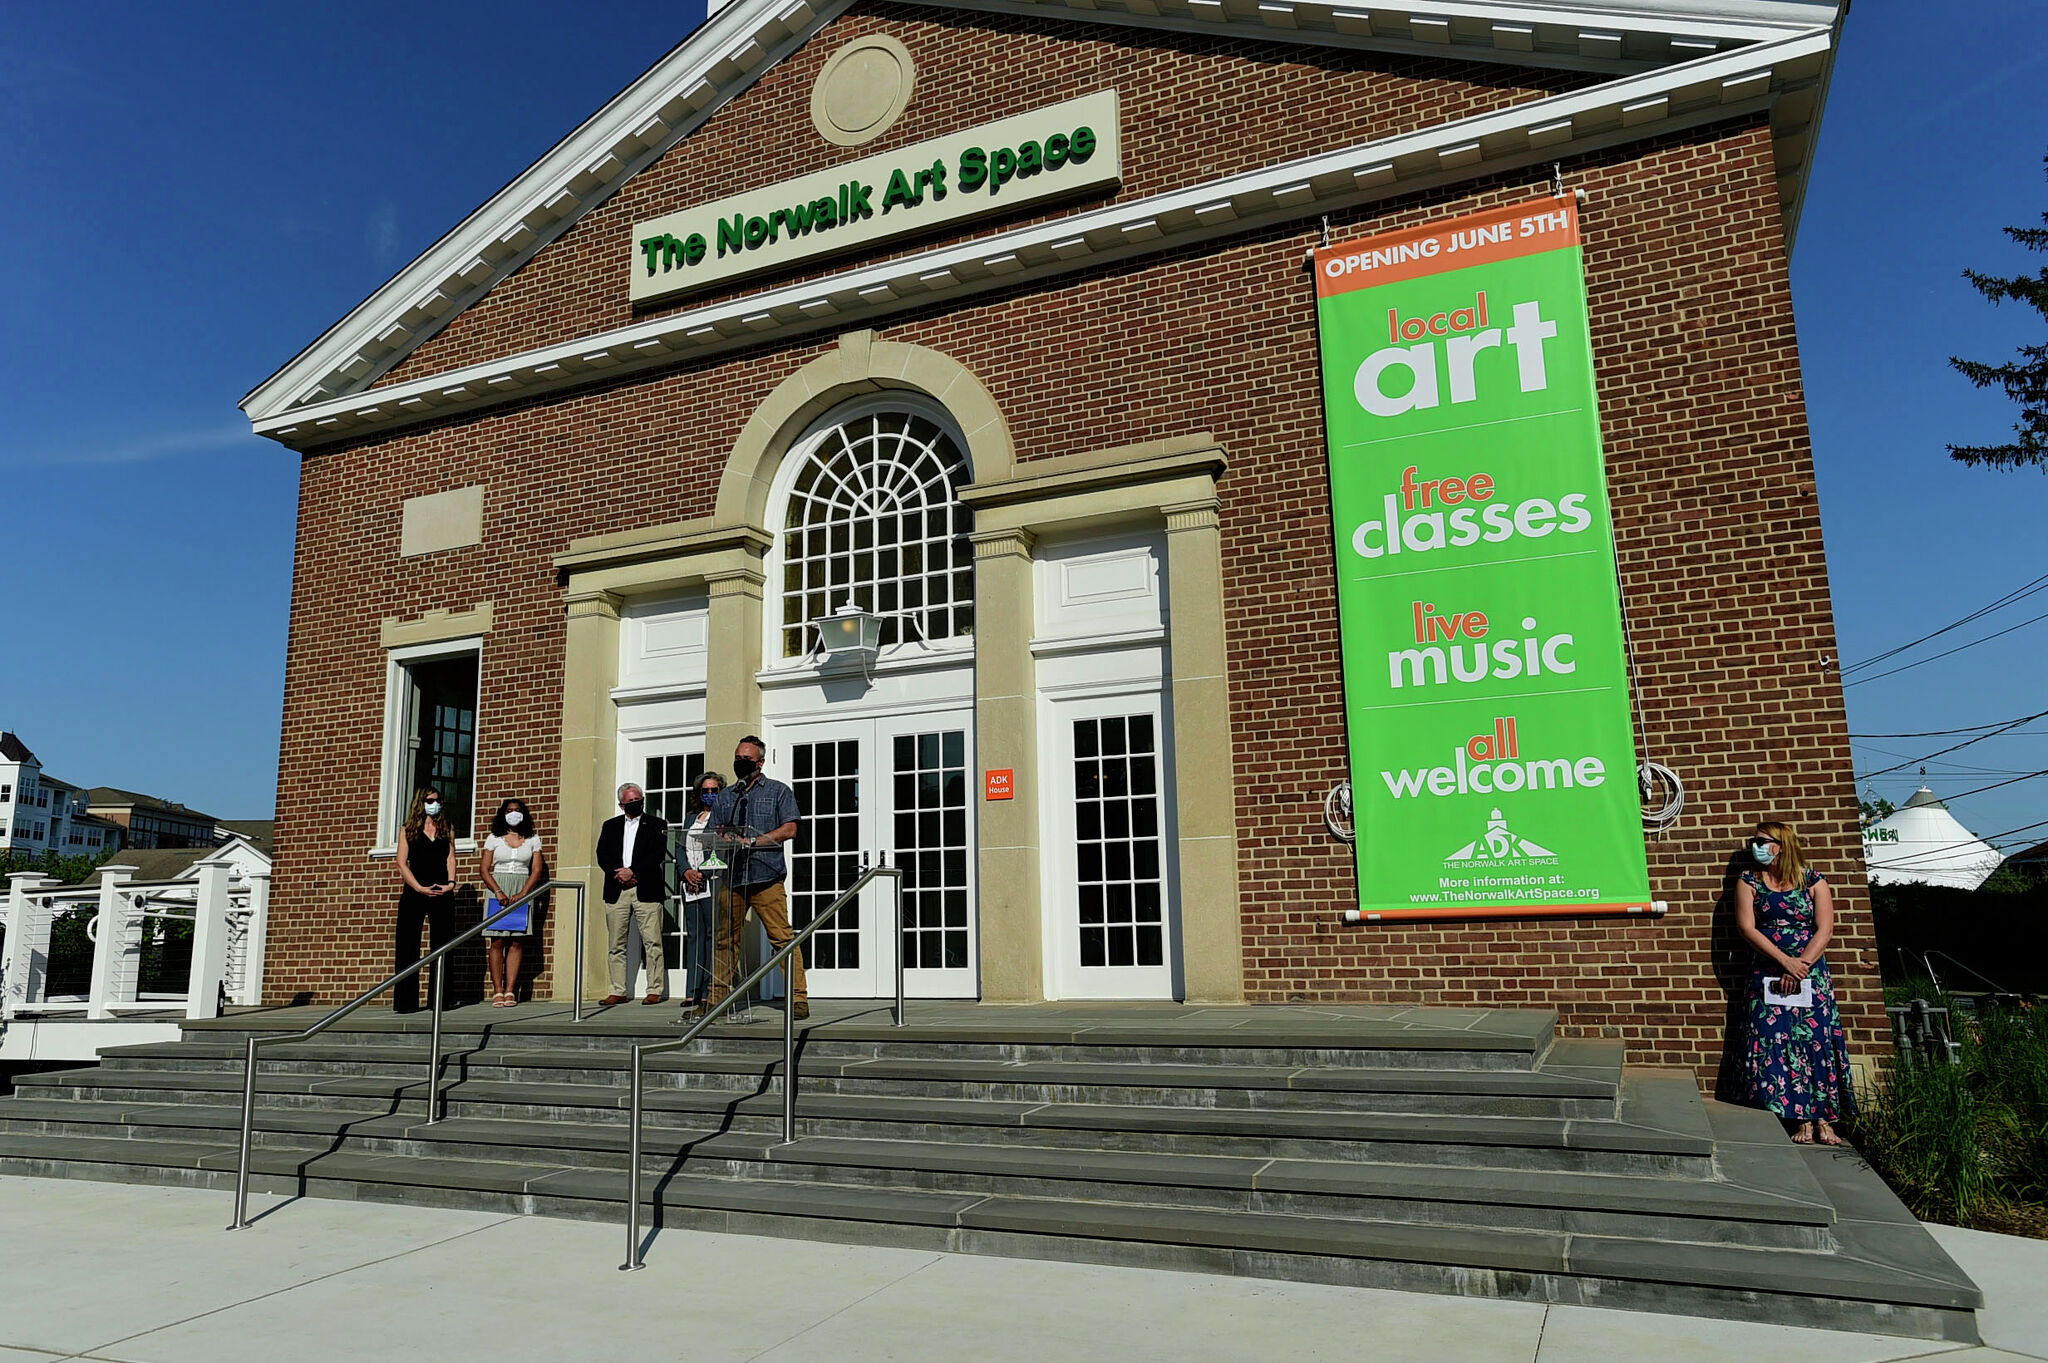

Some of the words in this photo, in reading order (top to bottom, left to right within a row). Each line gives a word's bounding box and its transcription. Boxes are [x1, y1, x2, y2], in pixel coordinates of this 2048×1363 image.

[640, 233, 706, 273] The
[717, 180, 873, 253] Norwalk
[886, 159, 947, 208] Art
[958, 125, 1097, 190] Space
[1325, 238, 1441, 278] OPENING
[1446, 222, 1513, 253] JUNE
[1519, 209, 1569, 238] 5TH
[1387, 290, 1489, 343] local
[1353, 300, 1558, 417] art
[1400, 465, 1495, 510] free
[1352, 493, 1592, 558] classes
[1411, 600, 1489, 644] live
[1388, 617, 1577, 689] music
[1466, 716, 1519, 761] all
[990, 775, 1008, 785] ADK
[1380, 746, 1606, 799] welcome
[1439, 877, 1470, 888] More
[1473, 874, 1545, 887] information
[1548, 874, 1565, 885] at:
[1442, 861, 1460, 869] THE
[1461, 859, 1505, 868] NORWALK
[1507, 858, 1527, 867] ART
[1529, 857, 1559, 866] SPACE
[1409, 887, 1600, 902] www.TheNorwalkArtSpace.org
